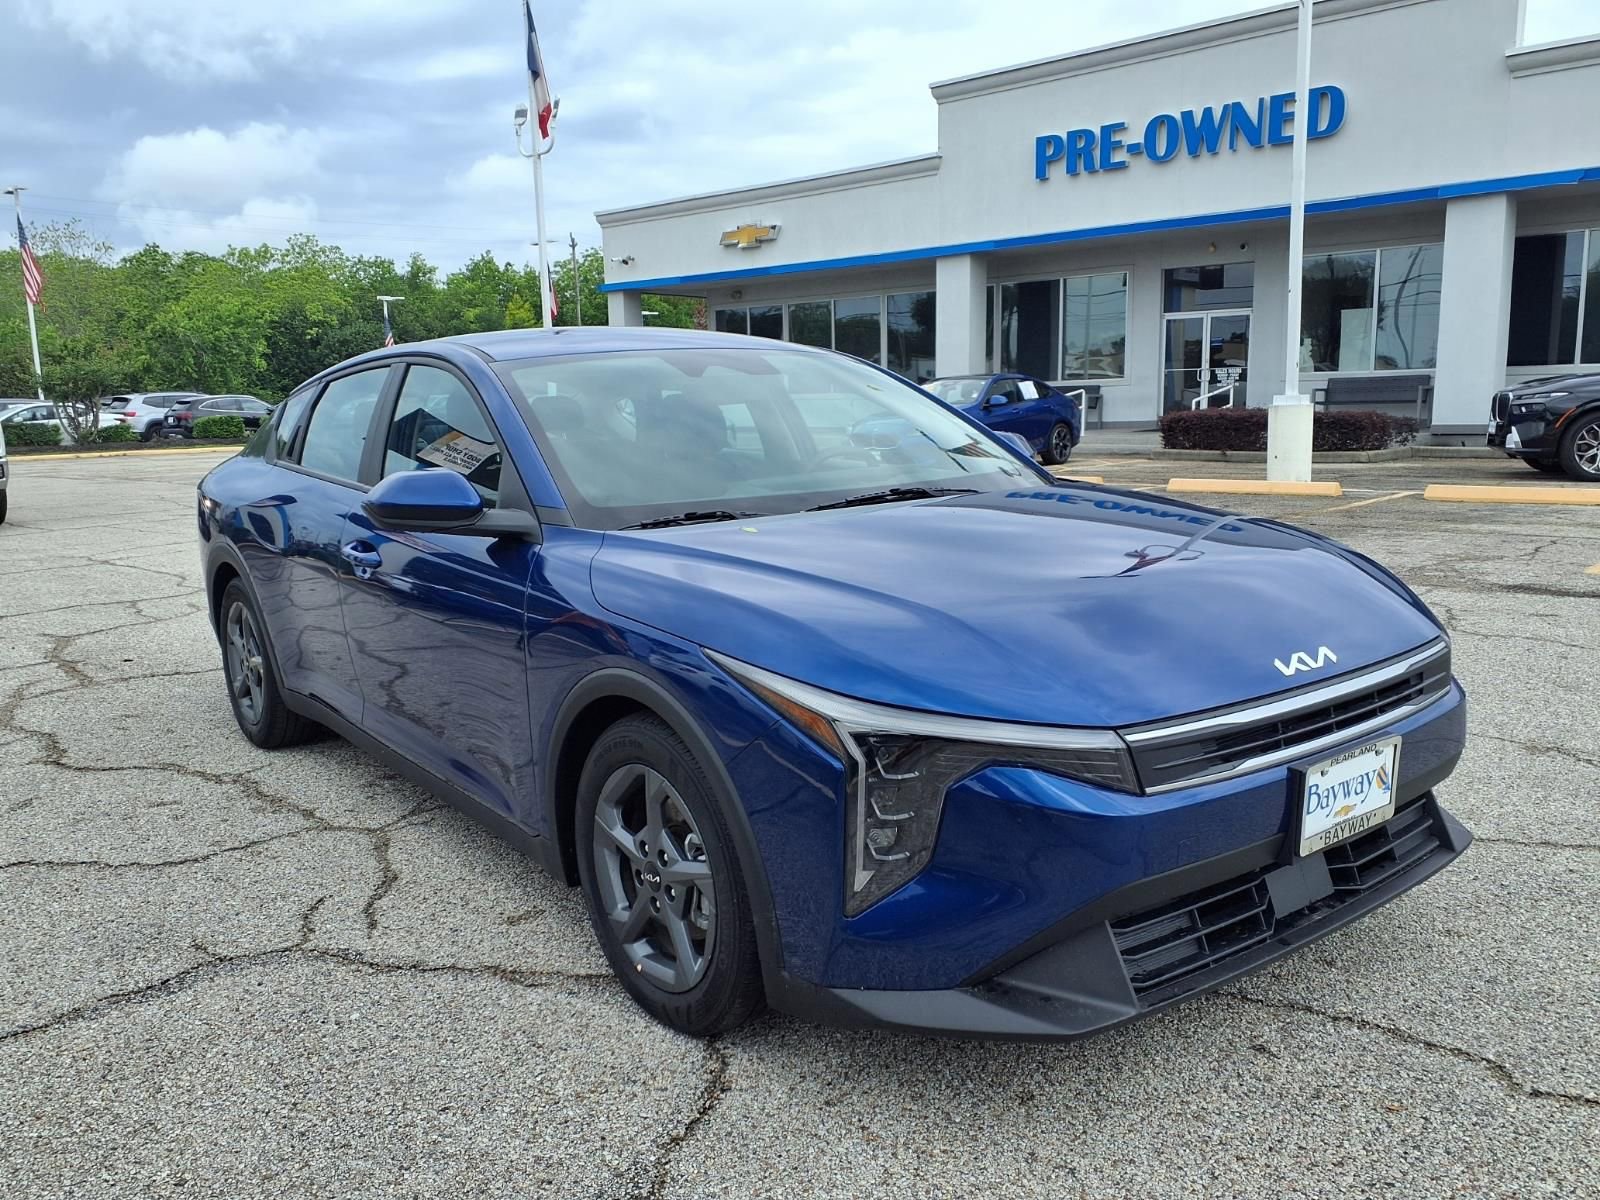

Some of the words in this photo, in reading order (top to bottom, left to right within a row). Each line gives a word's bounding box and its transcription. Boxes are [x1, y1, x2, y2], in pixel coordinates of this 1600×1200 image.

[1035, 85, 1347, 181] PRE-OWNED
[1273, 646, 1337, 676] KIA
[1330, 744, 1377, 766] PEARLAND
[1306, 769, 1377, 818] Bayway
[1324, 813, 1373, 845] BAYWAY
